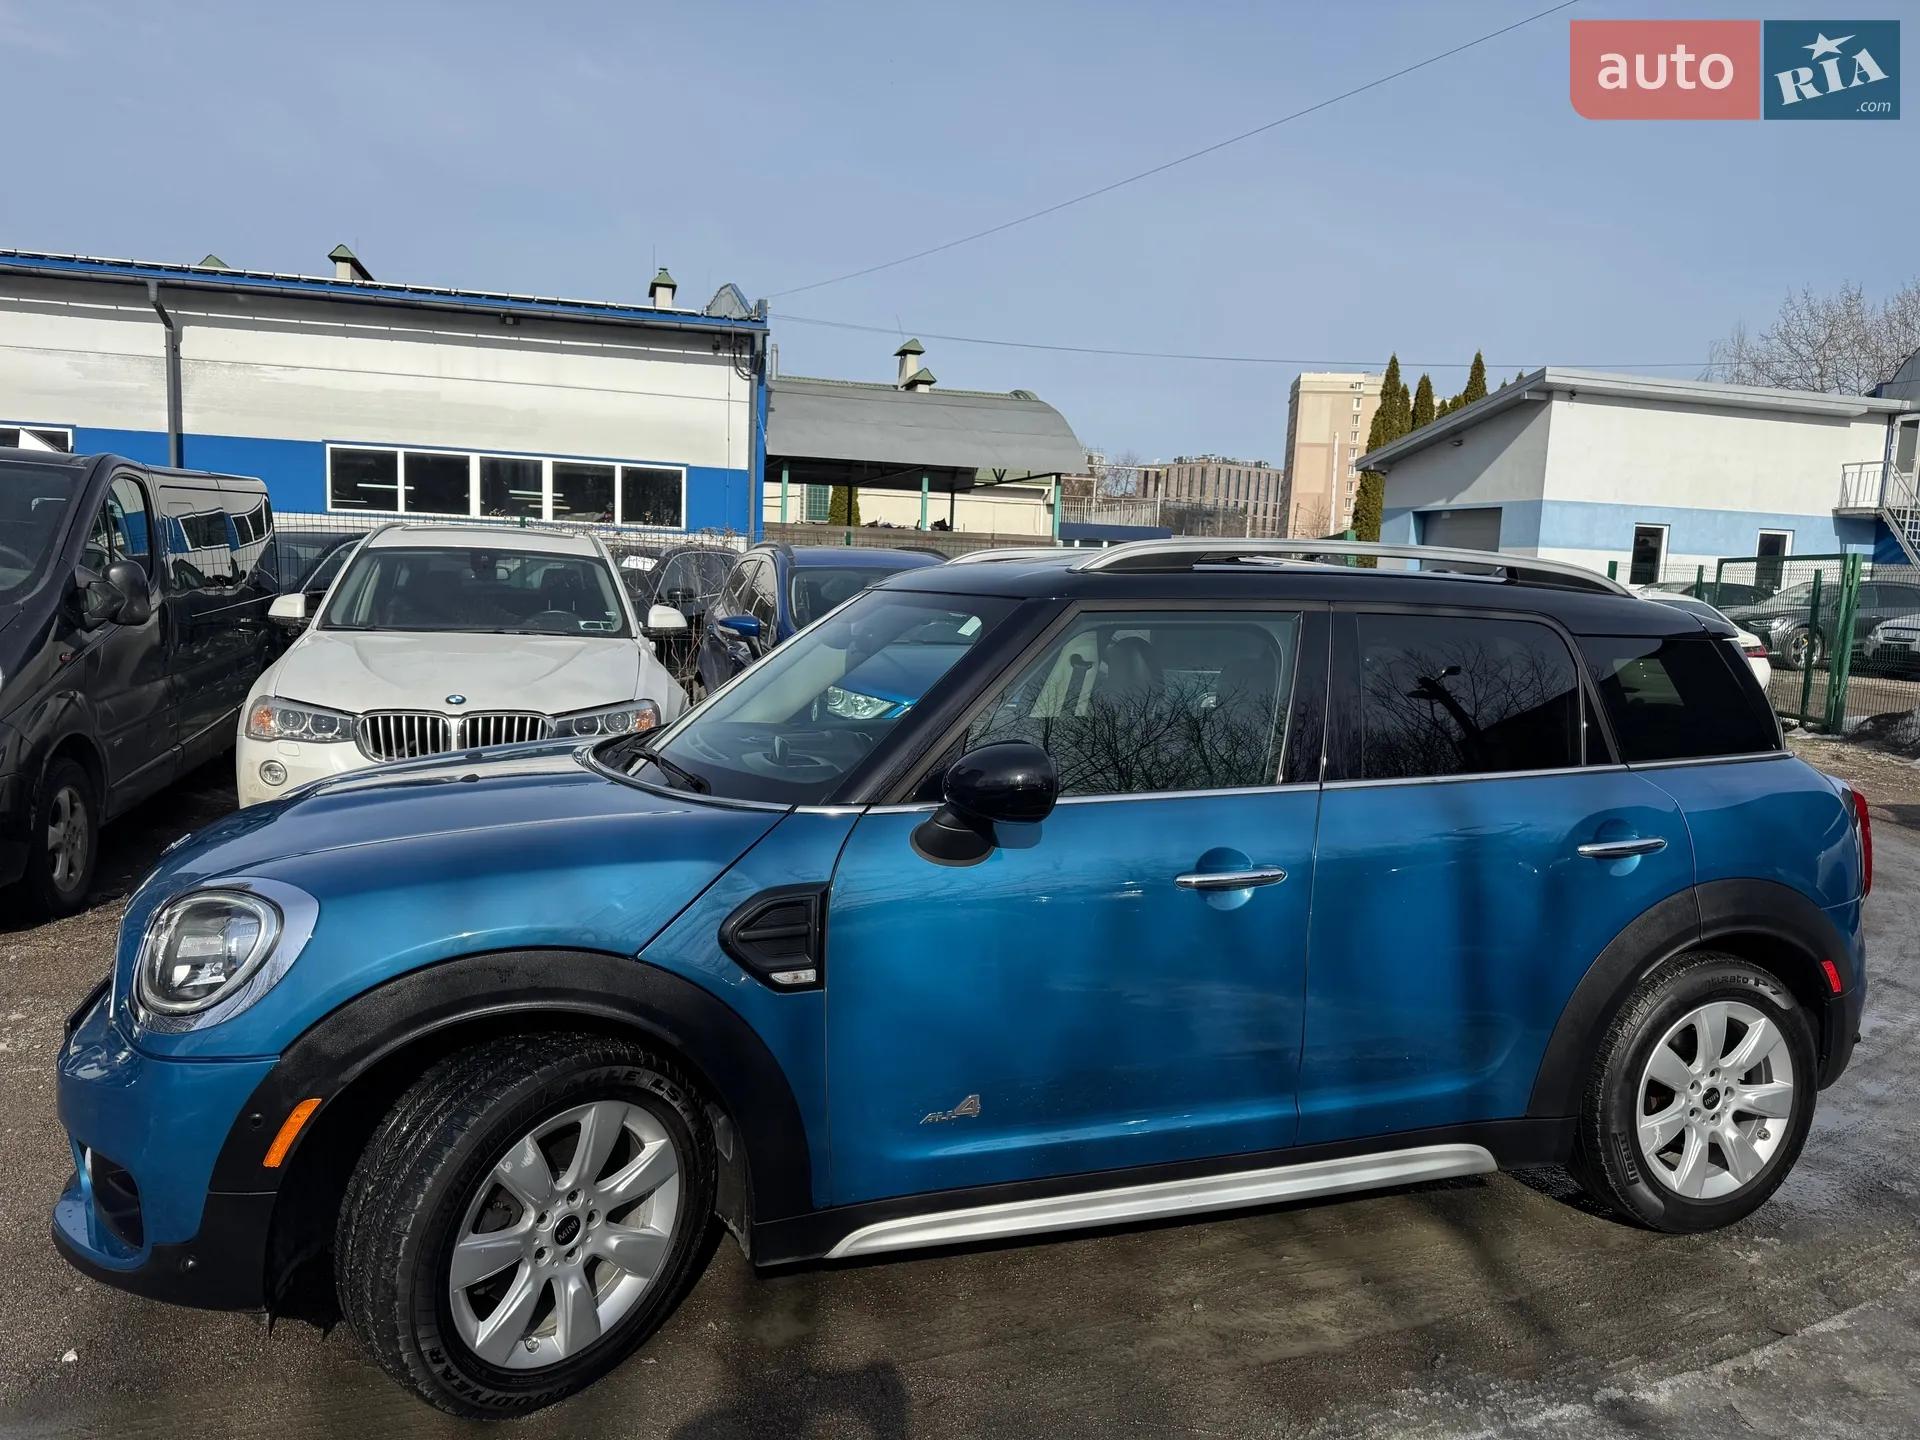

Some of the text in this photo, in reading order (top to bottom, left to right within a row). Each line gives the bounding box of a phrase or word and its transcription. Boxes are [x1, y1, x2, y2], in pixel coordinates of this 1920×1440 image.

[1753, 976, 1783, 996] P7
[1704, 1091, 1719, 1106] MINI
[557, 1219, 578, 1241] MINI
[428, 1347, 574, 1408] GOODYEAR
